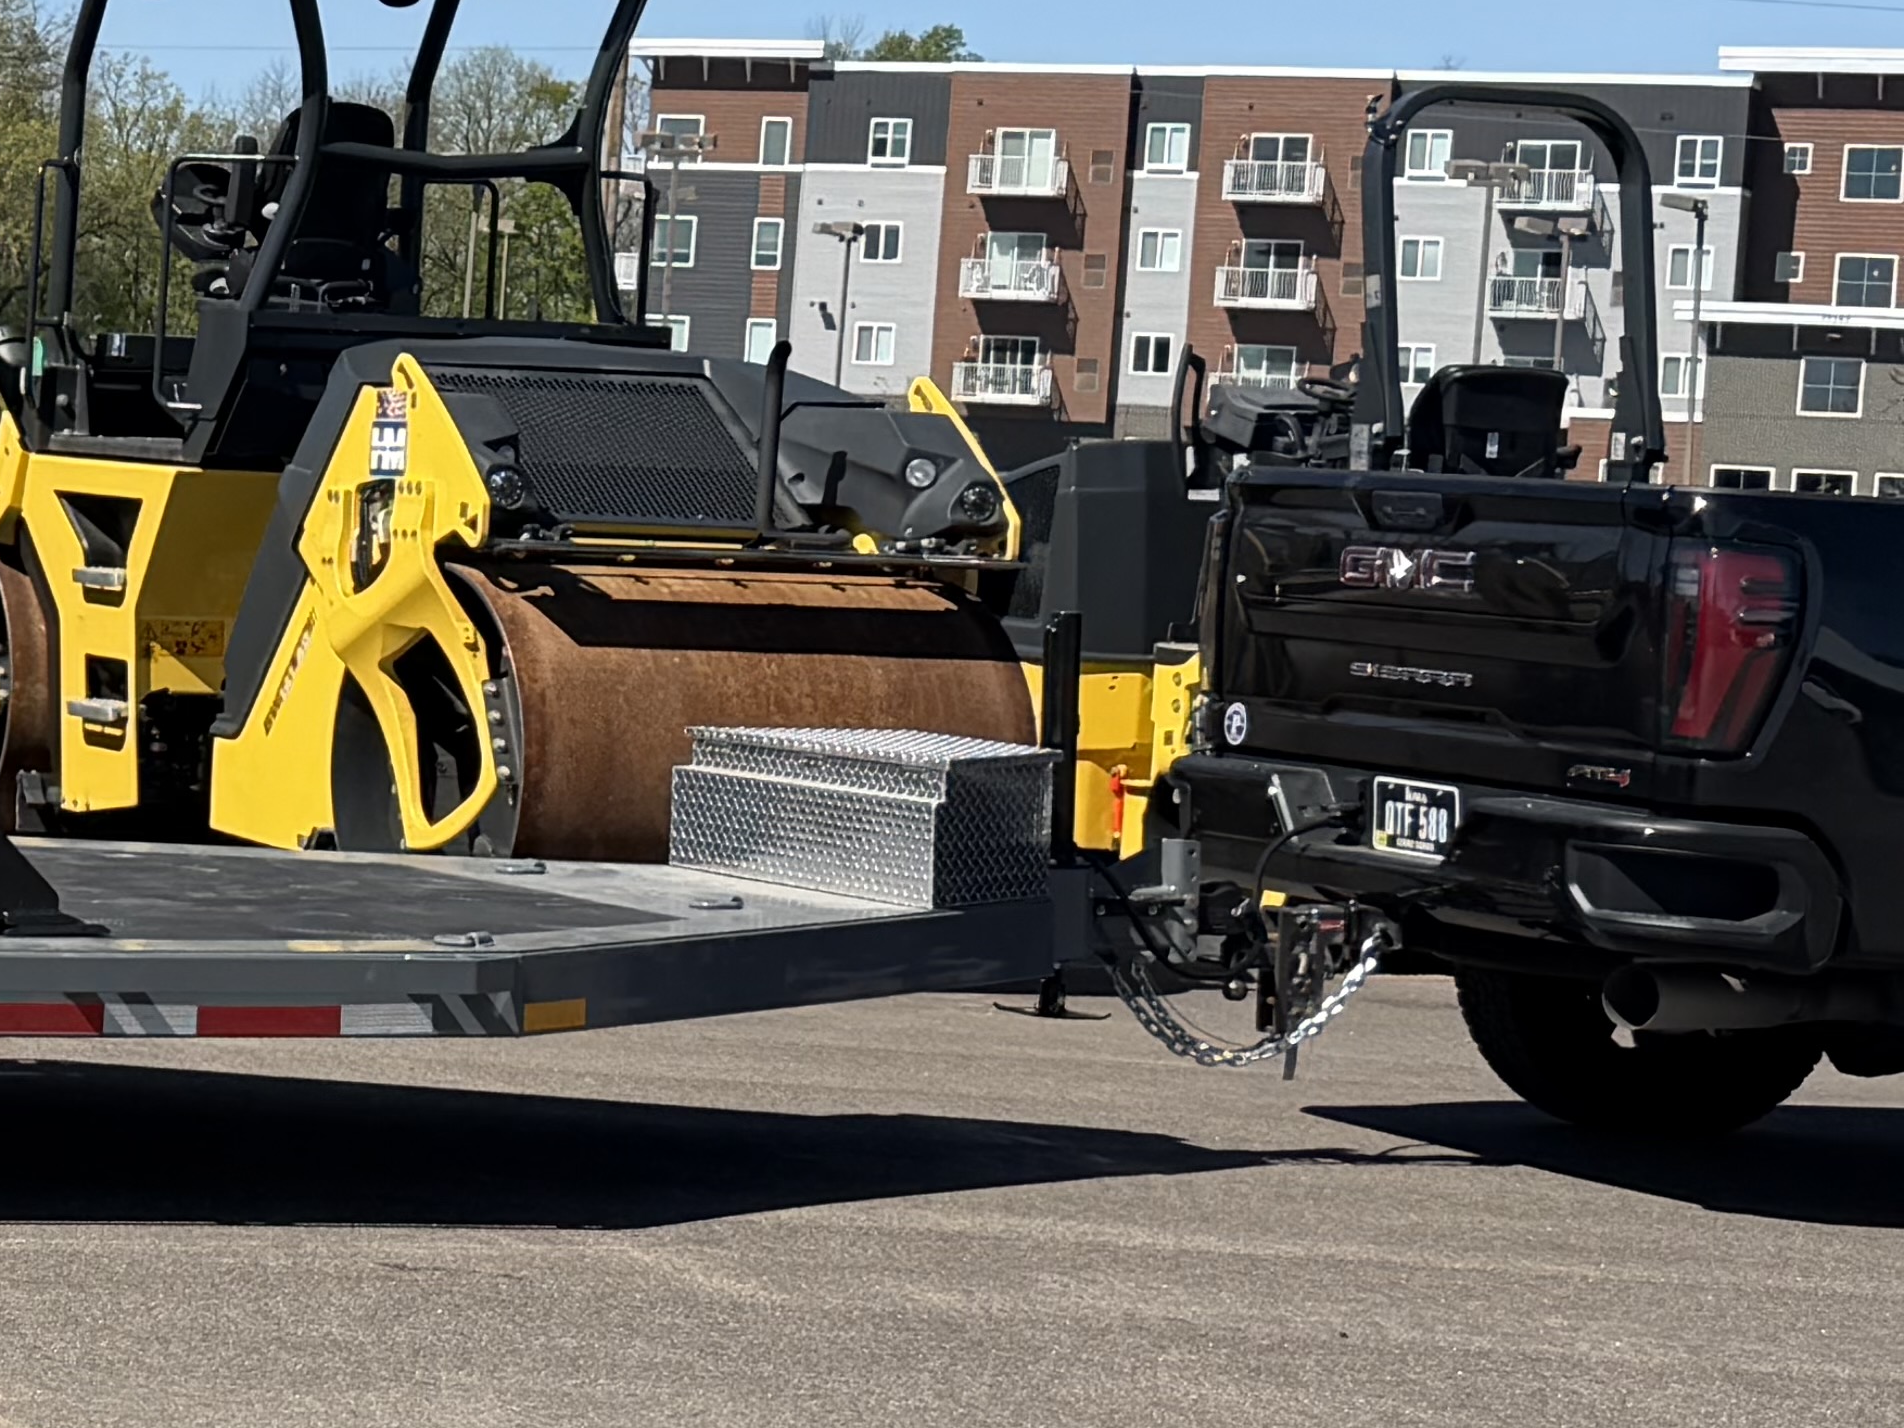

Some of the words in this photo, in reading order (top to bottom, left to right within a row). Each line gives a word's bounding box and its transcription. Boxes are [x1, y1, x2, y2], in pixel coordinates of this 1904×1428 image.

[1340, 545, 1477, 592] GMC
[1567, 764, 1631, 788] AT4
[1418, 805, 1448, 843] 588
